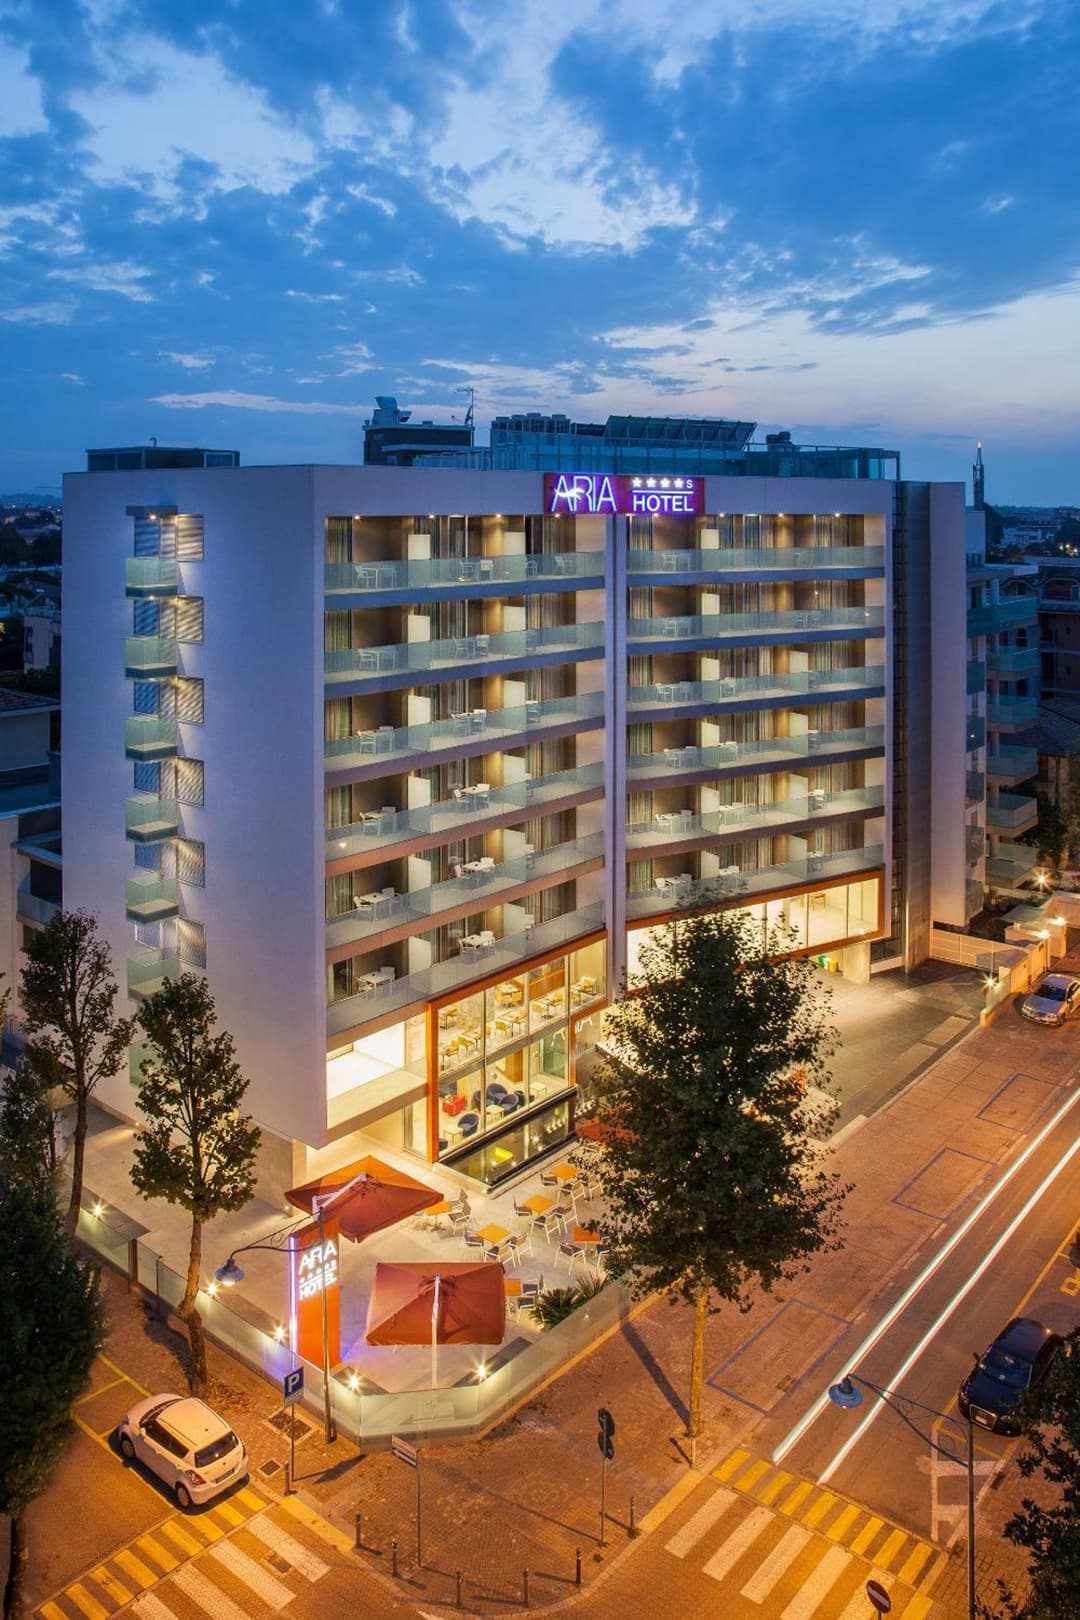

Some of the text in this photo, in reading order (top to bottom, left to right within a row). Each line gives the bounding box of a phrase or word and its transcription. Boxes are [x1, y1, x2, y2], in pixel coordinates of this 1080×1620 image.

[551, 475, 617, 512] ARIA
[632, 494, 694, 512] HOTEL
[298, 1239, 337, 1276] ARA
[288, 1373, 300, 1393] P
